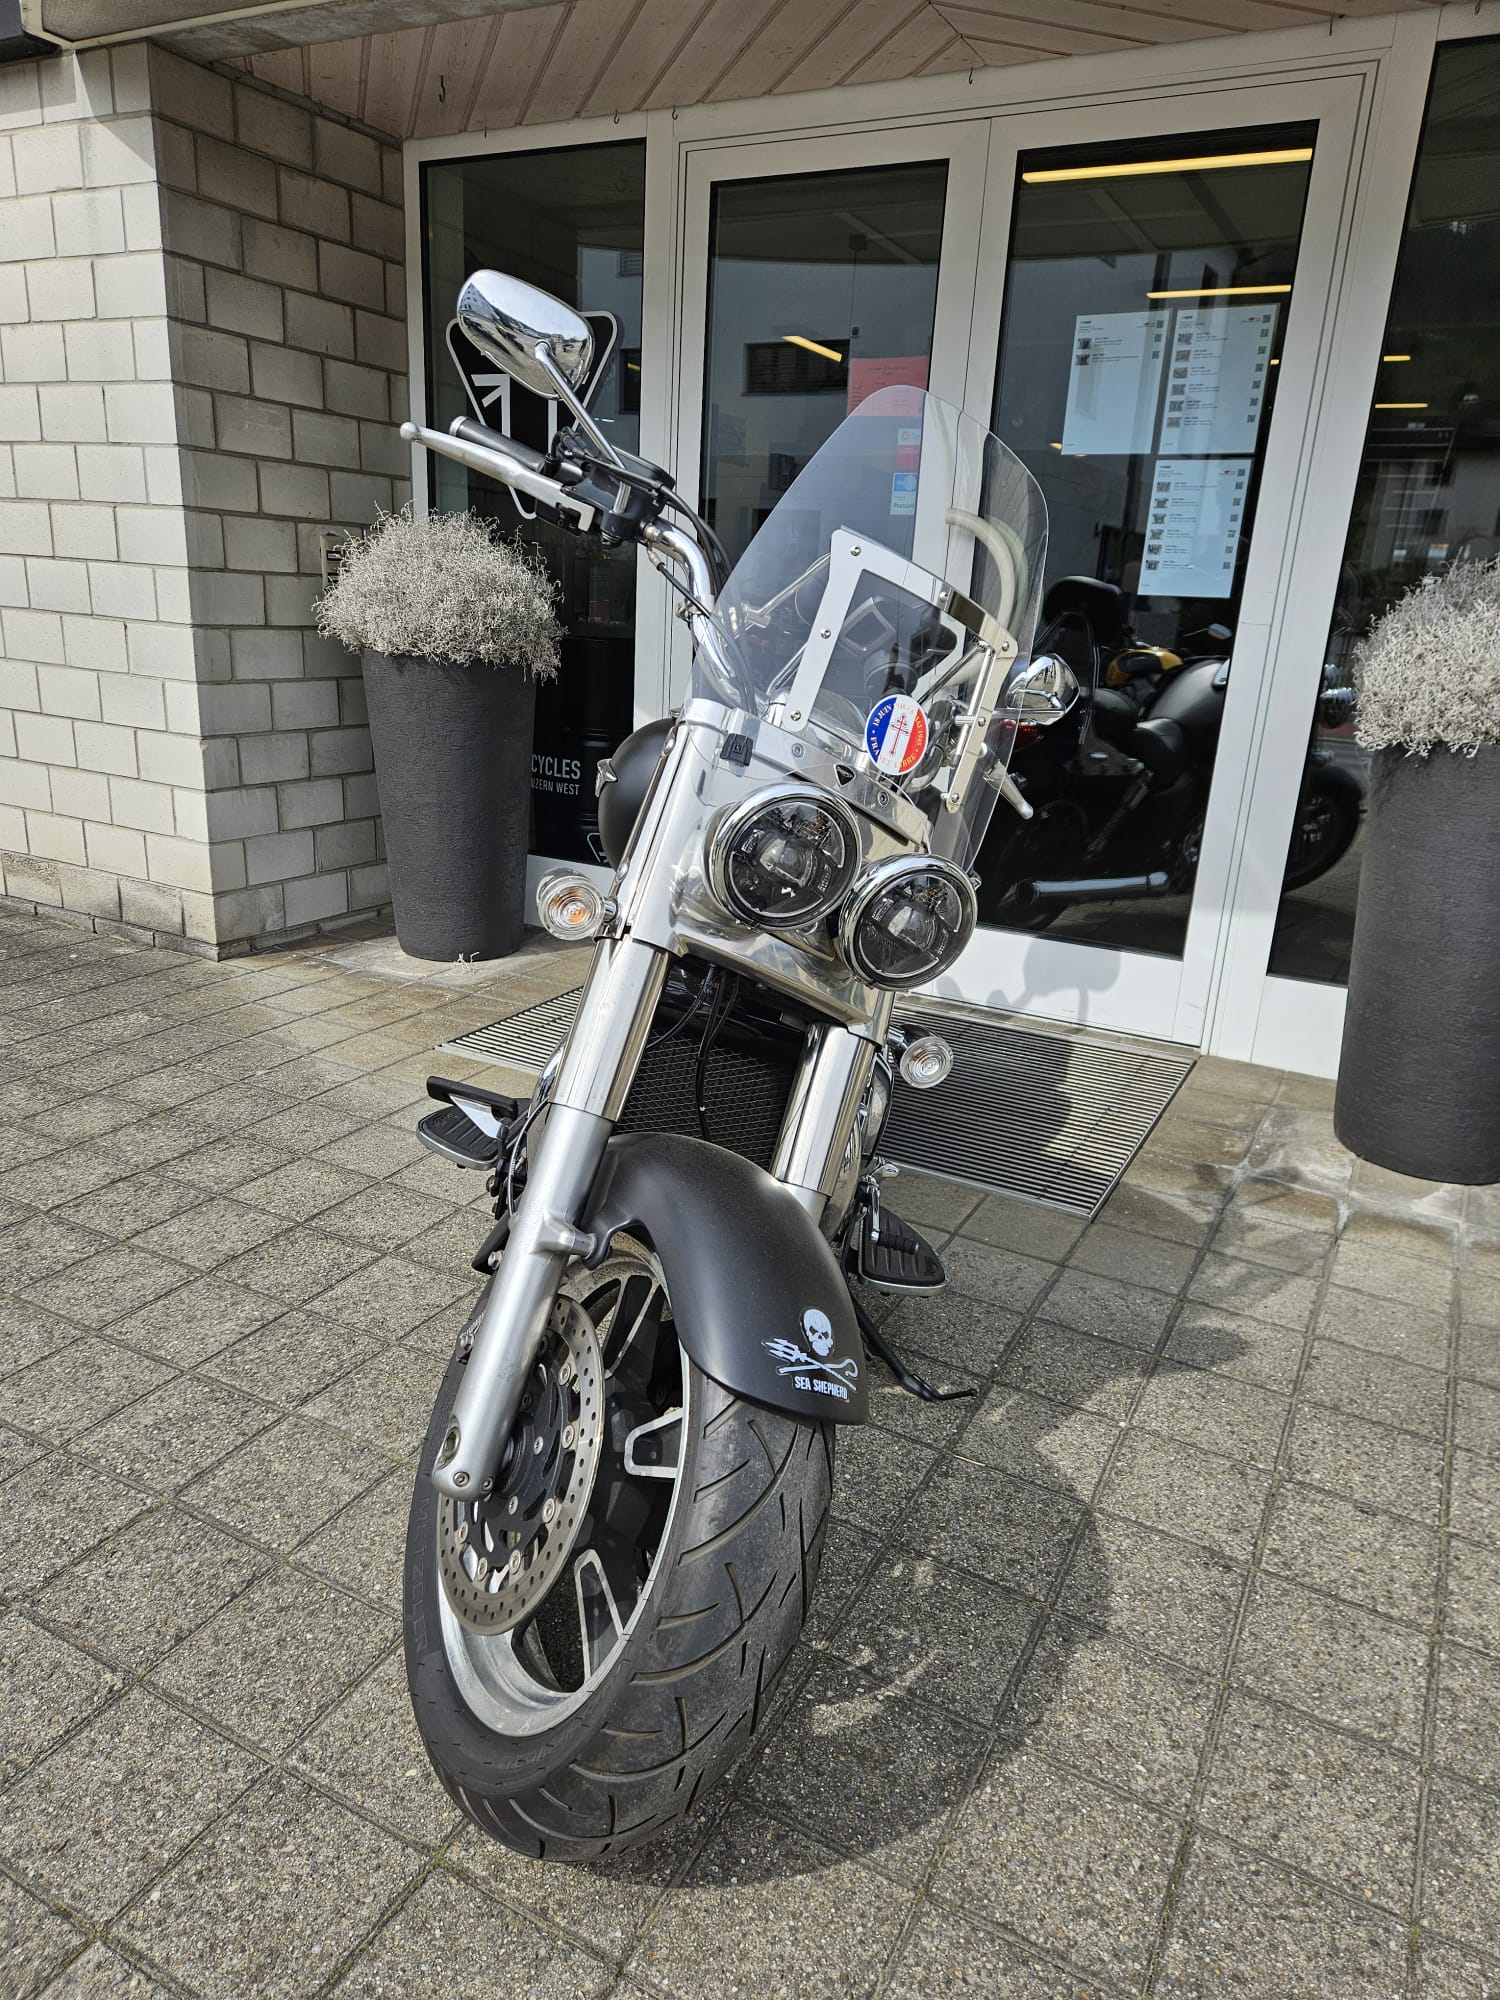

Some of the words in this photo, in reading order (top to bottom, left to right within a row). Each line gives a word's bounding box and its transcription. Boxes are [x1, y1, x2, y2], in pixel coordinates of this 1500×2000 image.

[531, 754, 581, 780] CYCLES
[556, 782, 581, 796] WEST
[794, 1376, 811, 1390] SEA
[812, 1379, 848, 1400] SHEPHERD
[412, 1494, 433, 1653] METZELER
